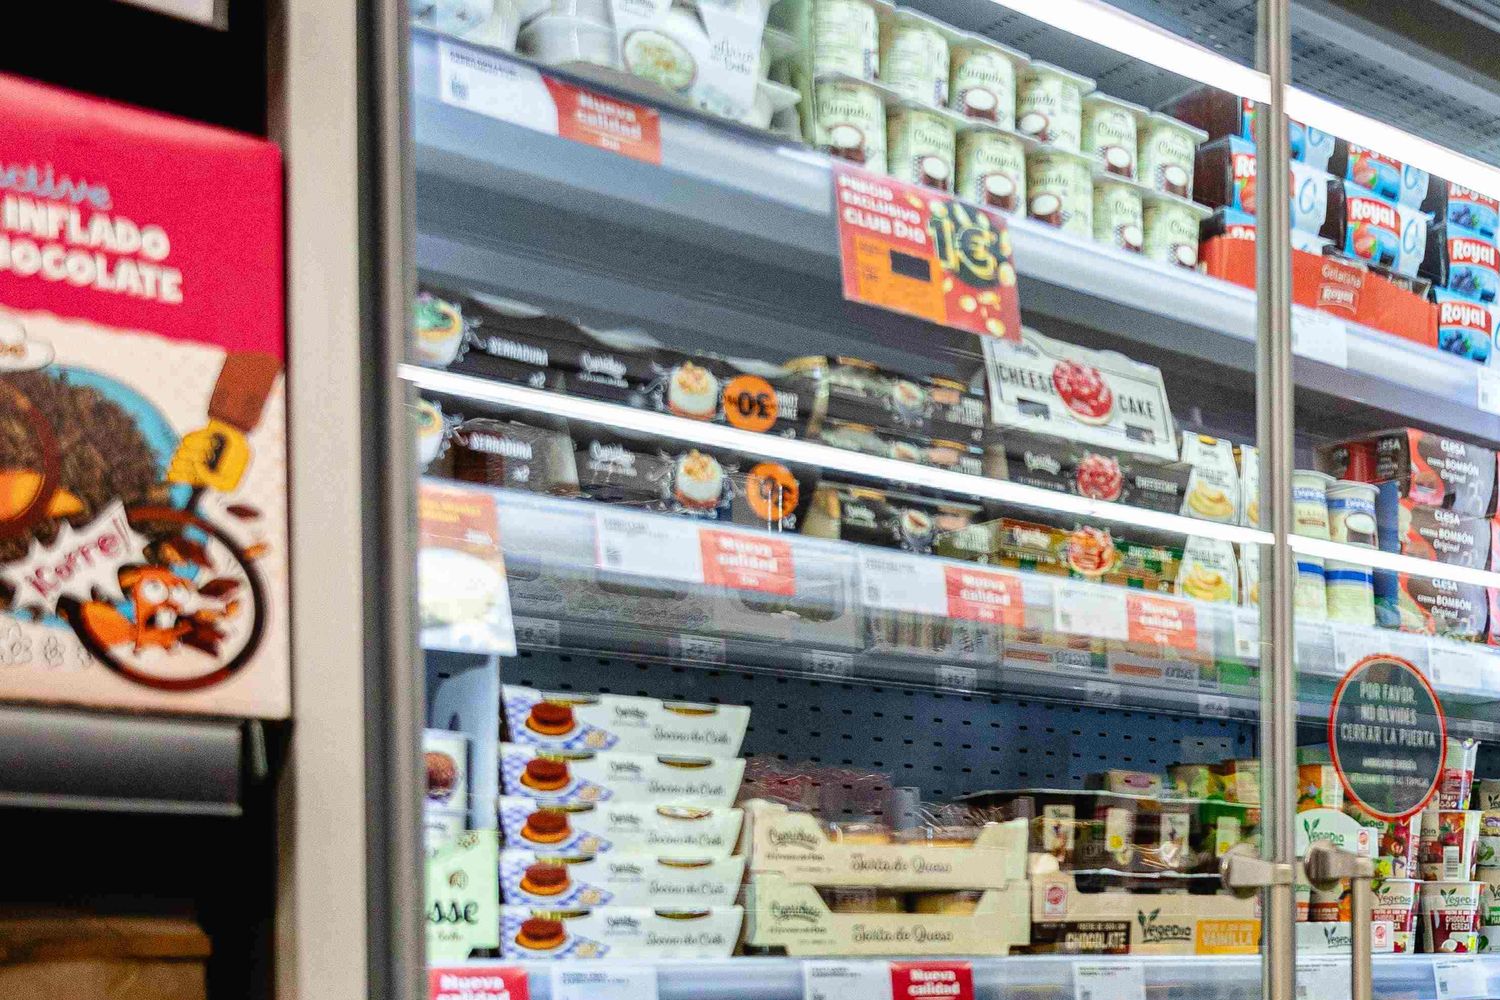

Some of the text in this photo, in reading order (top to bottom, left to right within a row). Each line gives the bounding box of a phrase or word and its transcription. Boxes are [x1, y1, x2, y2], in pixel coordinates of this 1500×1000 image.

[842, 189, 922, 226] EXCLUSIVO
[843, 207, 892, 236] CLUB
[1350, 199, 1397, 229] Royal
[4, 196, 170, 261] INFLADO
[1452, 238, 1498, 268] Royal
[1440, 301, 1487, 329] Royal
[1118, 393, 1155, 421] CAKE
[1340, 723, 1437, 749] CERRAR LA PUERTA
[439, 974, 505, 992] Nueva
[907, 981, 961, 997] calidad
[908, 968, 957, 984] Nueva
